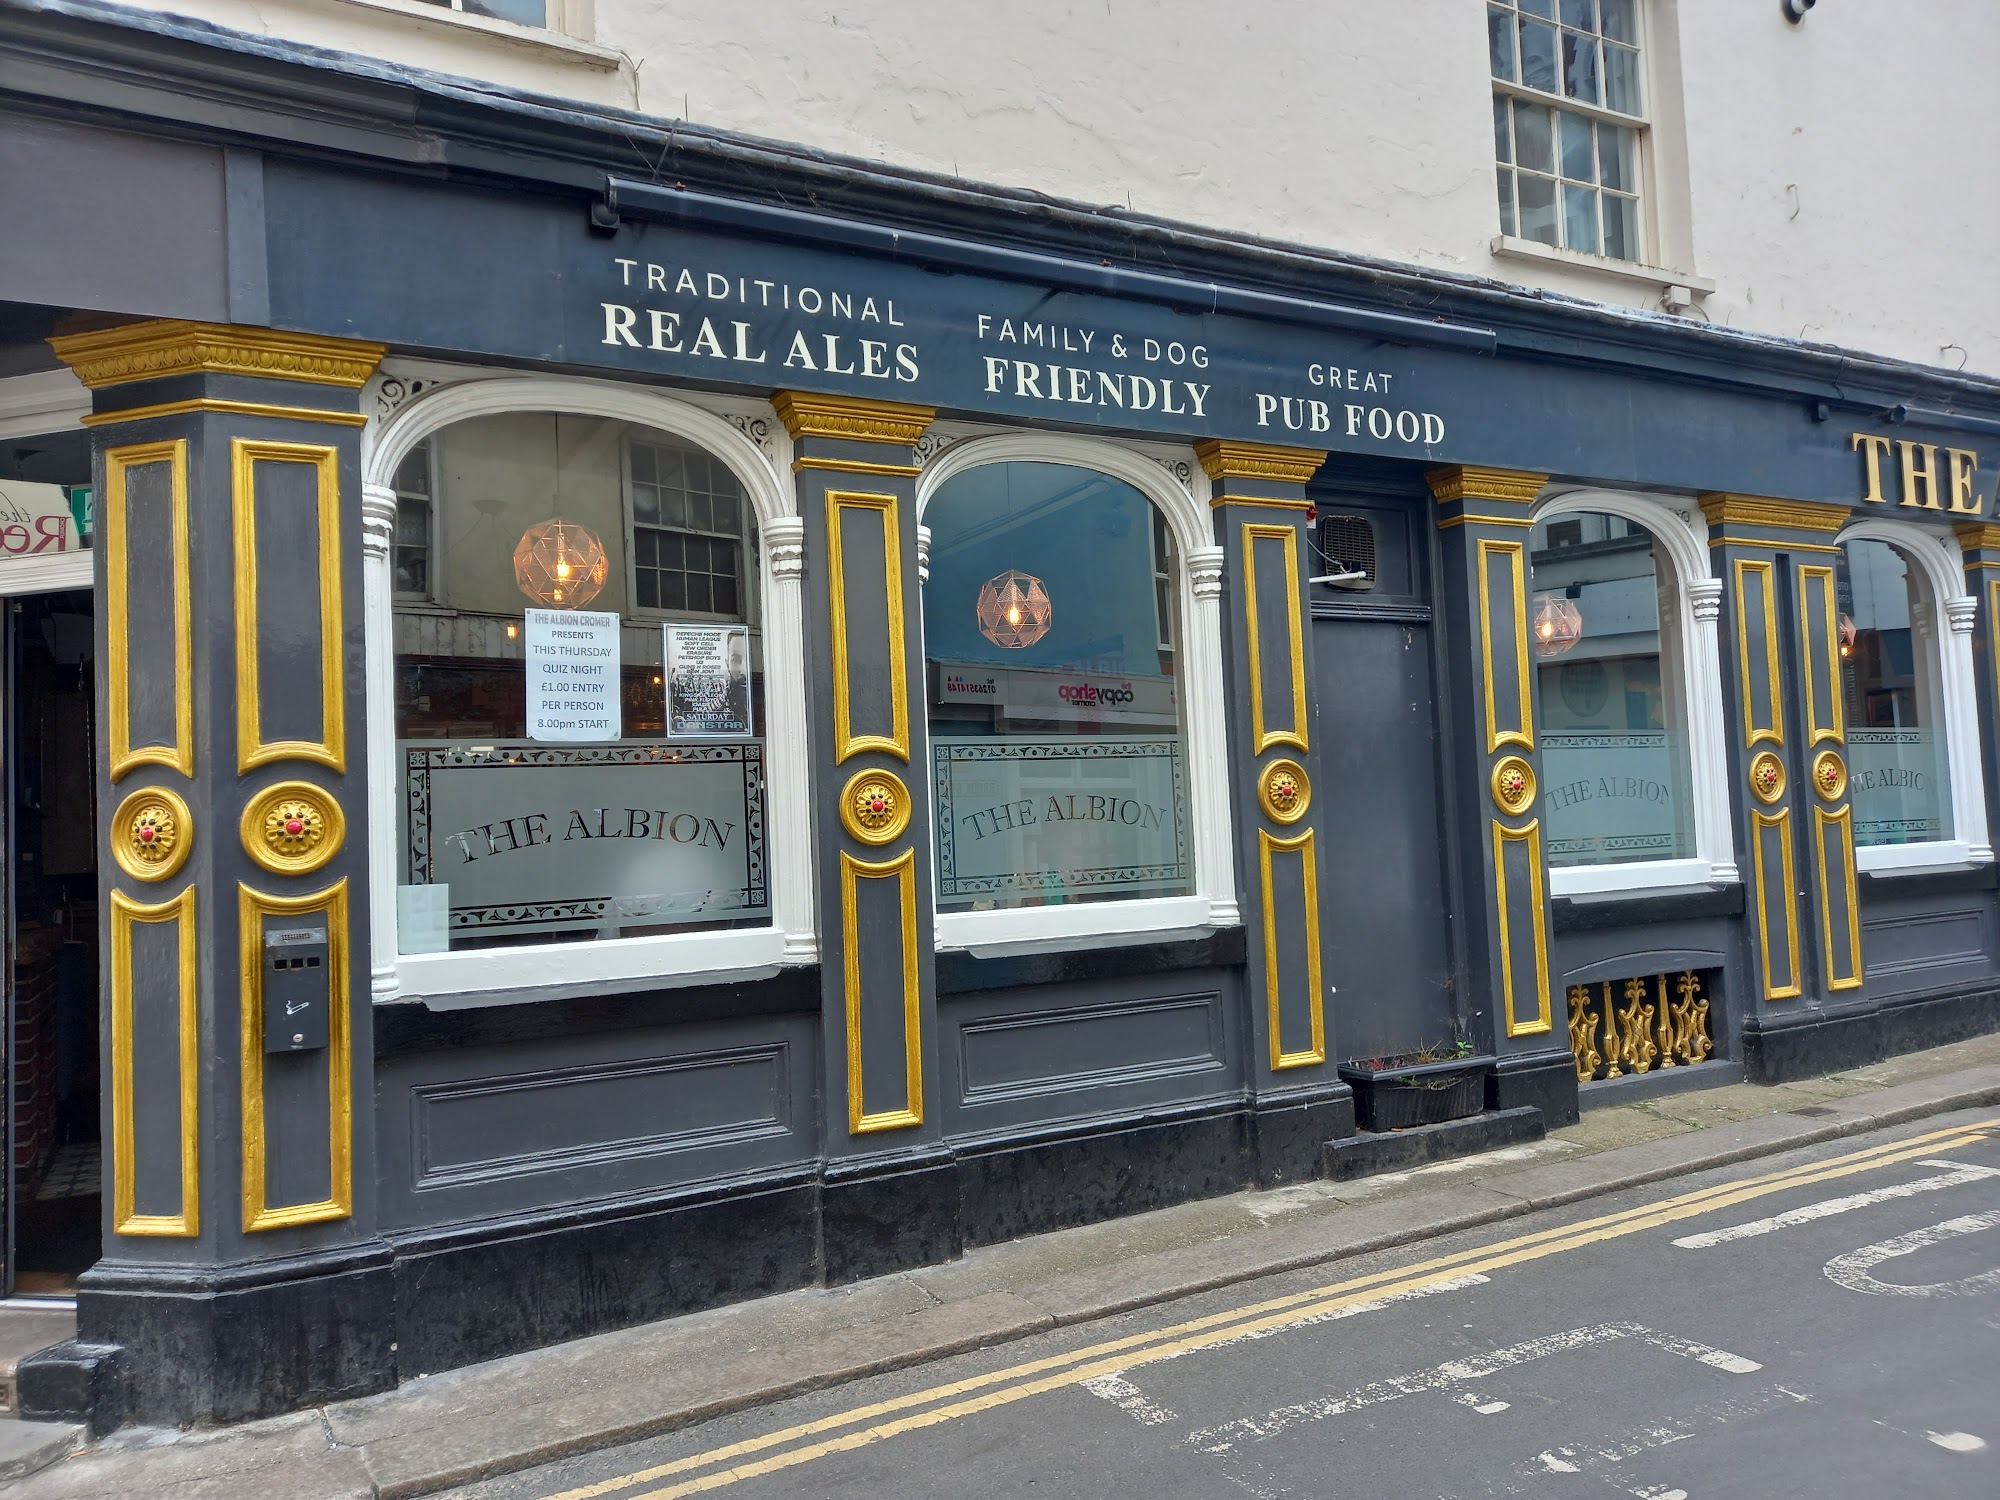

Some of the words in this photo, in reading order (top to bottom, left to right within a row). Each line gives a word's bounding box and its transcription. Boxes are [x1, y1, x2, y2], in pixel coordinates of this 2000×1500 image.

[614, 257, 905, 327] TRADITIONAL
[600, 302, 766, 363] REAL
[782, 329, 919, 382] ALES
[977, 314, 1095, 353] FAMILY
[1111, 333, 1128, 358] &
[1144, 338, 1209, 369] DOG
[982, 356, 1212, 417] FRIENDLY
[1308, 363, 1392, 394] GREAT
[1255, 393, 1331, 432] PUB
[1344, 404, 1445, 444] FOOD
[1852, 432, 1983, 515] THE
[534, 613, 549, 625] THE
[551, 614, 578, 626] ALBION
[580, 615, 610, 627] CROMER
[552, 630, 594, 639] PRESENTS
[533, 645, 556, 655] THIS
[559, 646, 611, 657] THURSDAY
[542, 664, 568, 674] QUIZ
[571, 665, 603, 674] NIGHT
[541, 682, 569, 692] £1.00
[572, 683, 604, 692] ENTRY
[542, 701, 560, 710] PER
[564, 701, 604, 710] PERSON
[538, 719, 575, 730] 8.00pm
[578, 720, 609, 729] START
[1545, 780, 1593, 812] THE
[962, 799, 1037, 840] THE
[1044, 795, 1166, 832] ALBION
[446, 813, 552, 864] THE
[563, 808, 736, 851] ALBION
